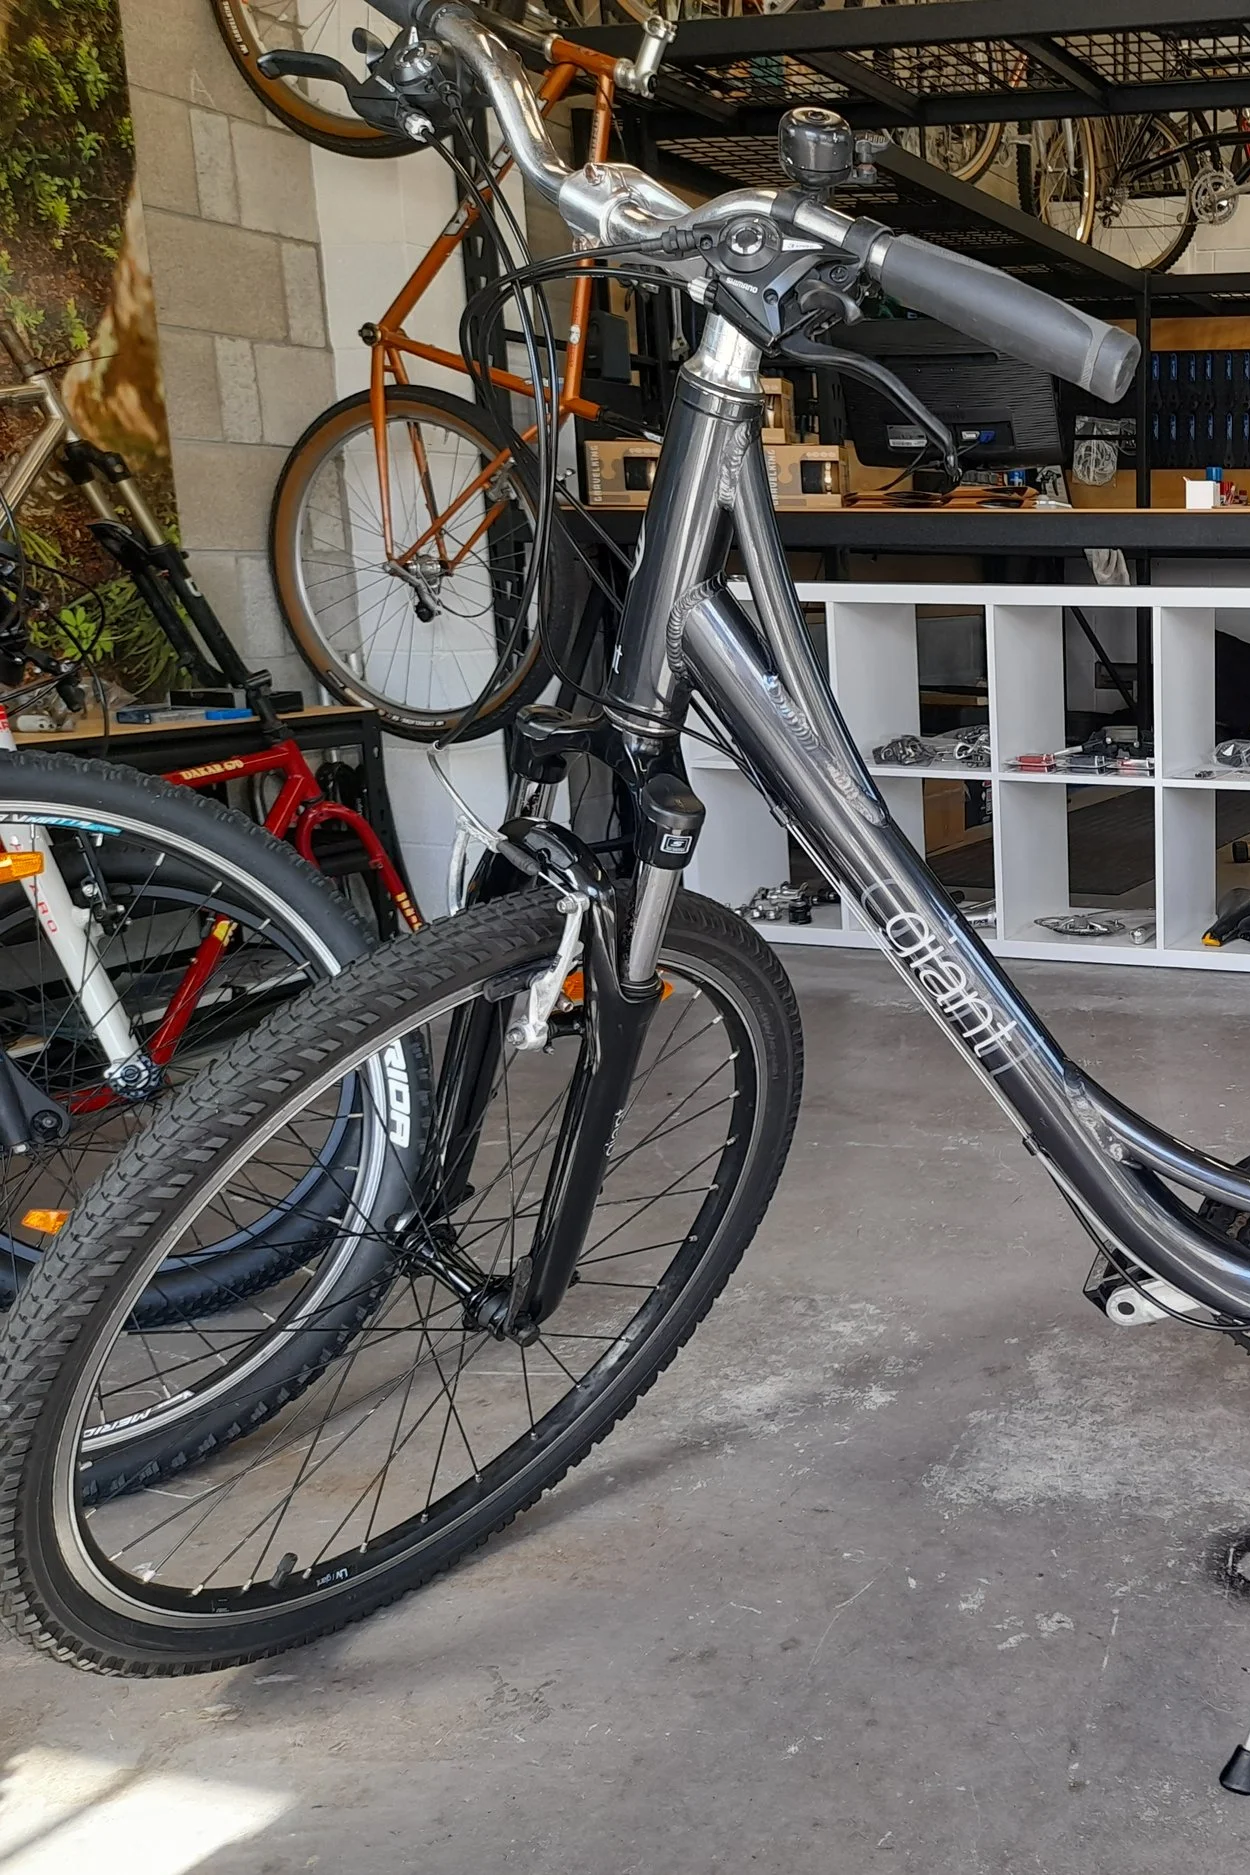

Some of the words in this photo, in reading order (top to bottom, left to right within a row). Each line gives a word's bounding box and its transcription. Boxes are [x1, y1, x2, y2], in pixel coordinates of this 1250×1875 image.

[726, 276, 759, 294] SHIMANO
[179, 763, 225, 780] DAKAR
[878, 911, 1018, 1059] giant
[384, 1038, 411, 1149] RIDA
[82, 1407, 153, 1439] MERID
